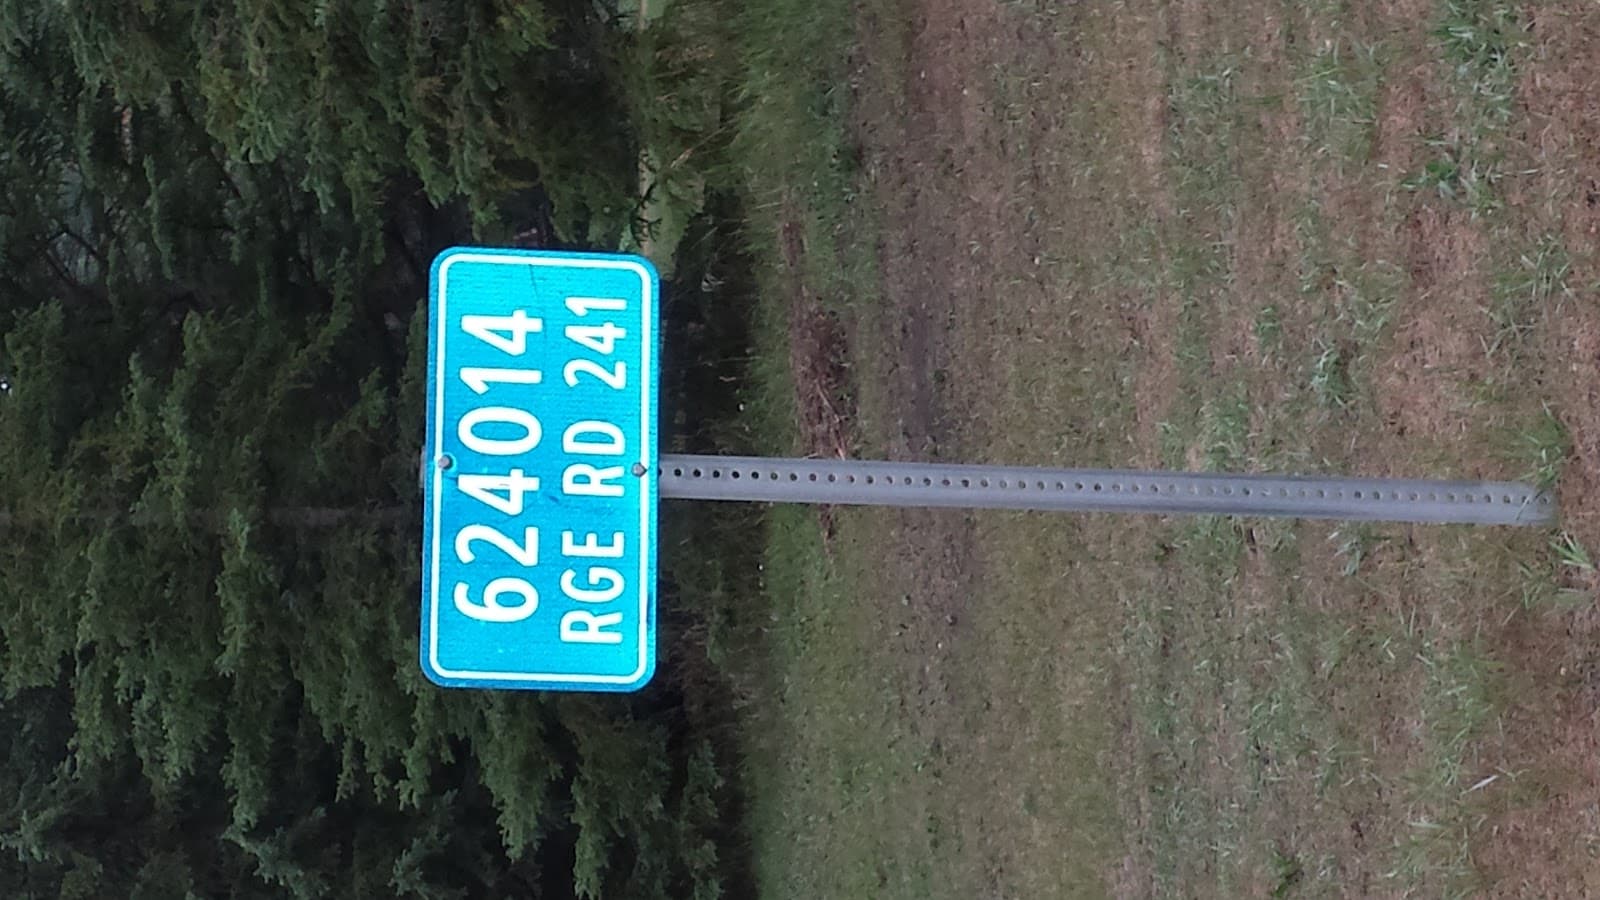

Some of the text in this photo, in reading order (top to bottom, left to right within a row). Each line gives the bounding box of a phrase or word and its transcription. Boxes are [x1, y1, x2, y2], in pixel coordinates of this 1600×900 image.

[454, 310, 542, 621] 624014
[561, 297, 627, 643] RGE RD 241
